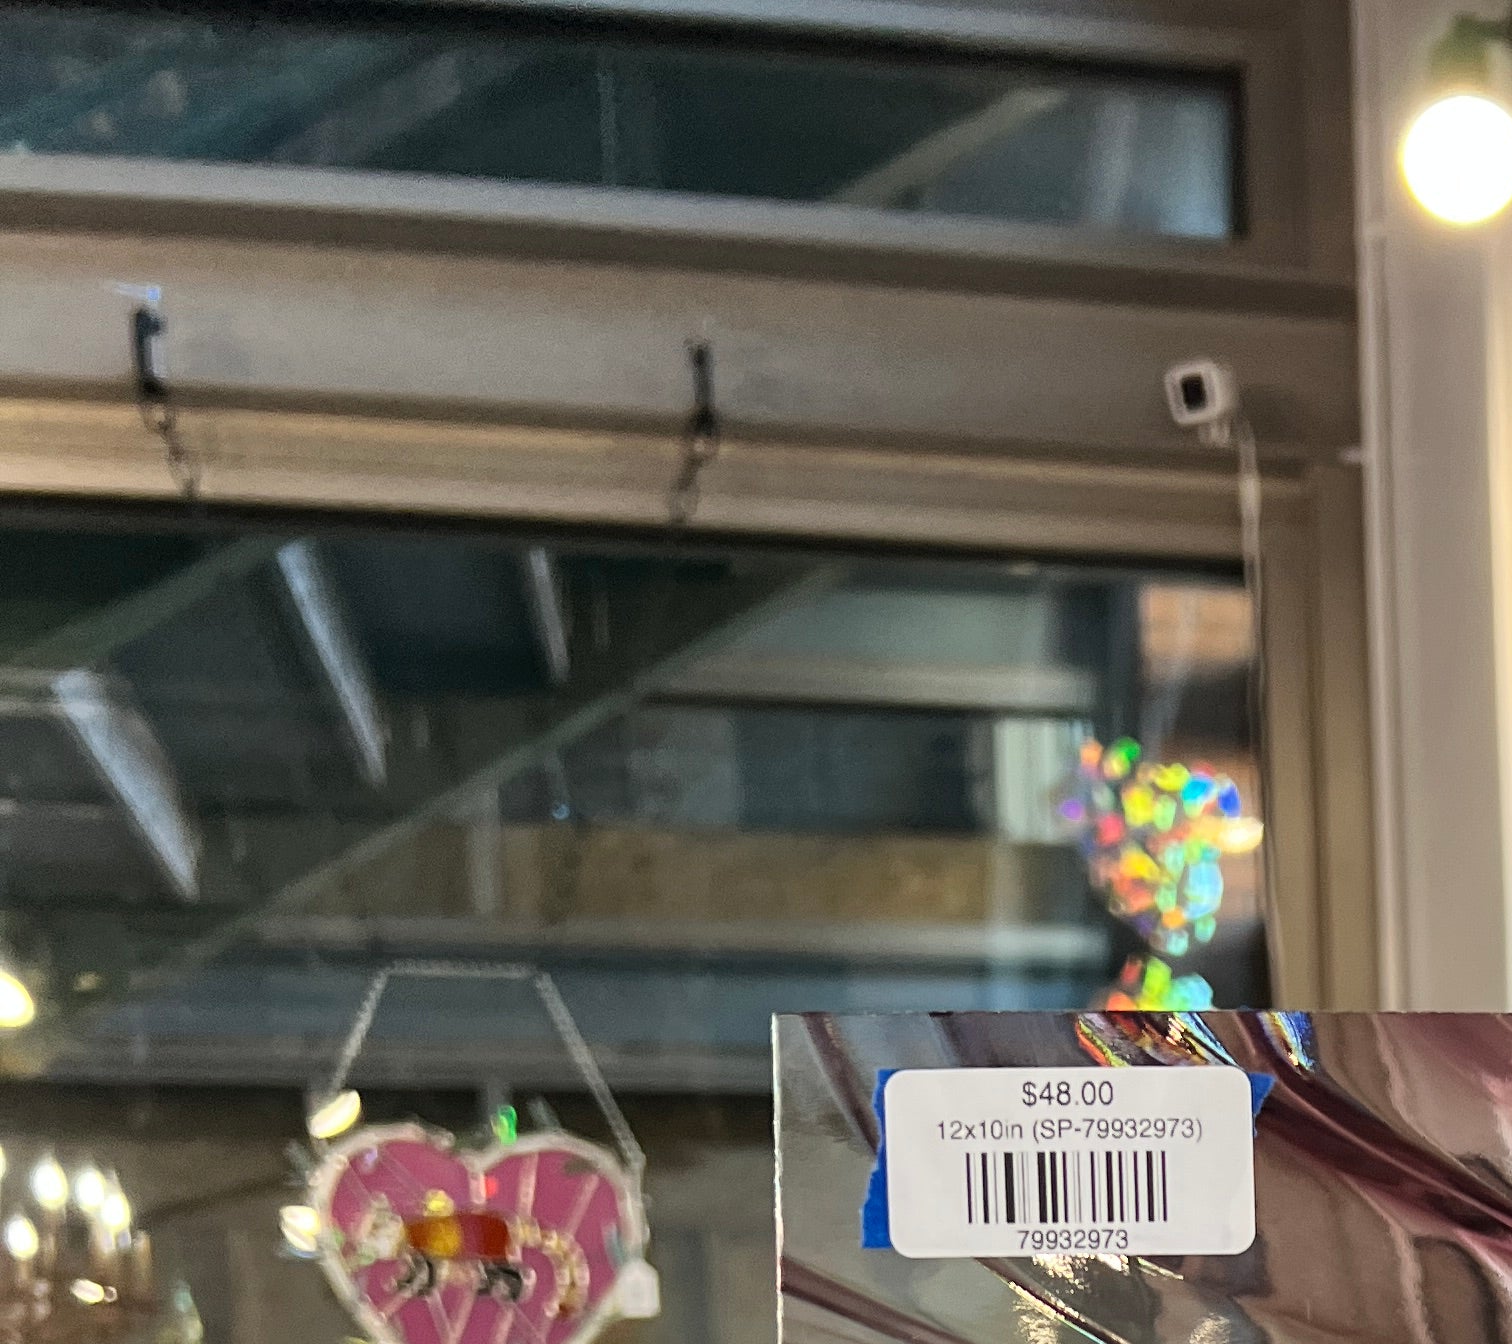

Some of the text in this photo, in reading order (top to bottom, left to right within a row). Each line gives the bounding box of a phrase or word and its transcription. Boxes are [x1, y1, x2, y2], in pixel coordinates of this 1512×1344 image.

[1021, 1080, 1114, 1107] $48.00
[937, 1117, 1202, 1144] 12x10in (SP-79932973)
[1016, 1229, 1129, 1250] 79932973
